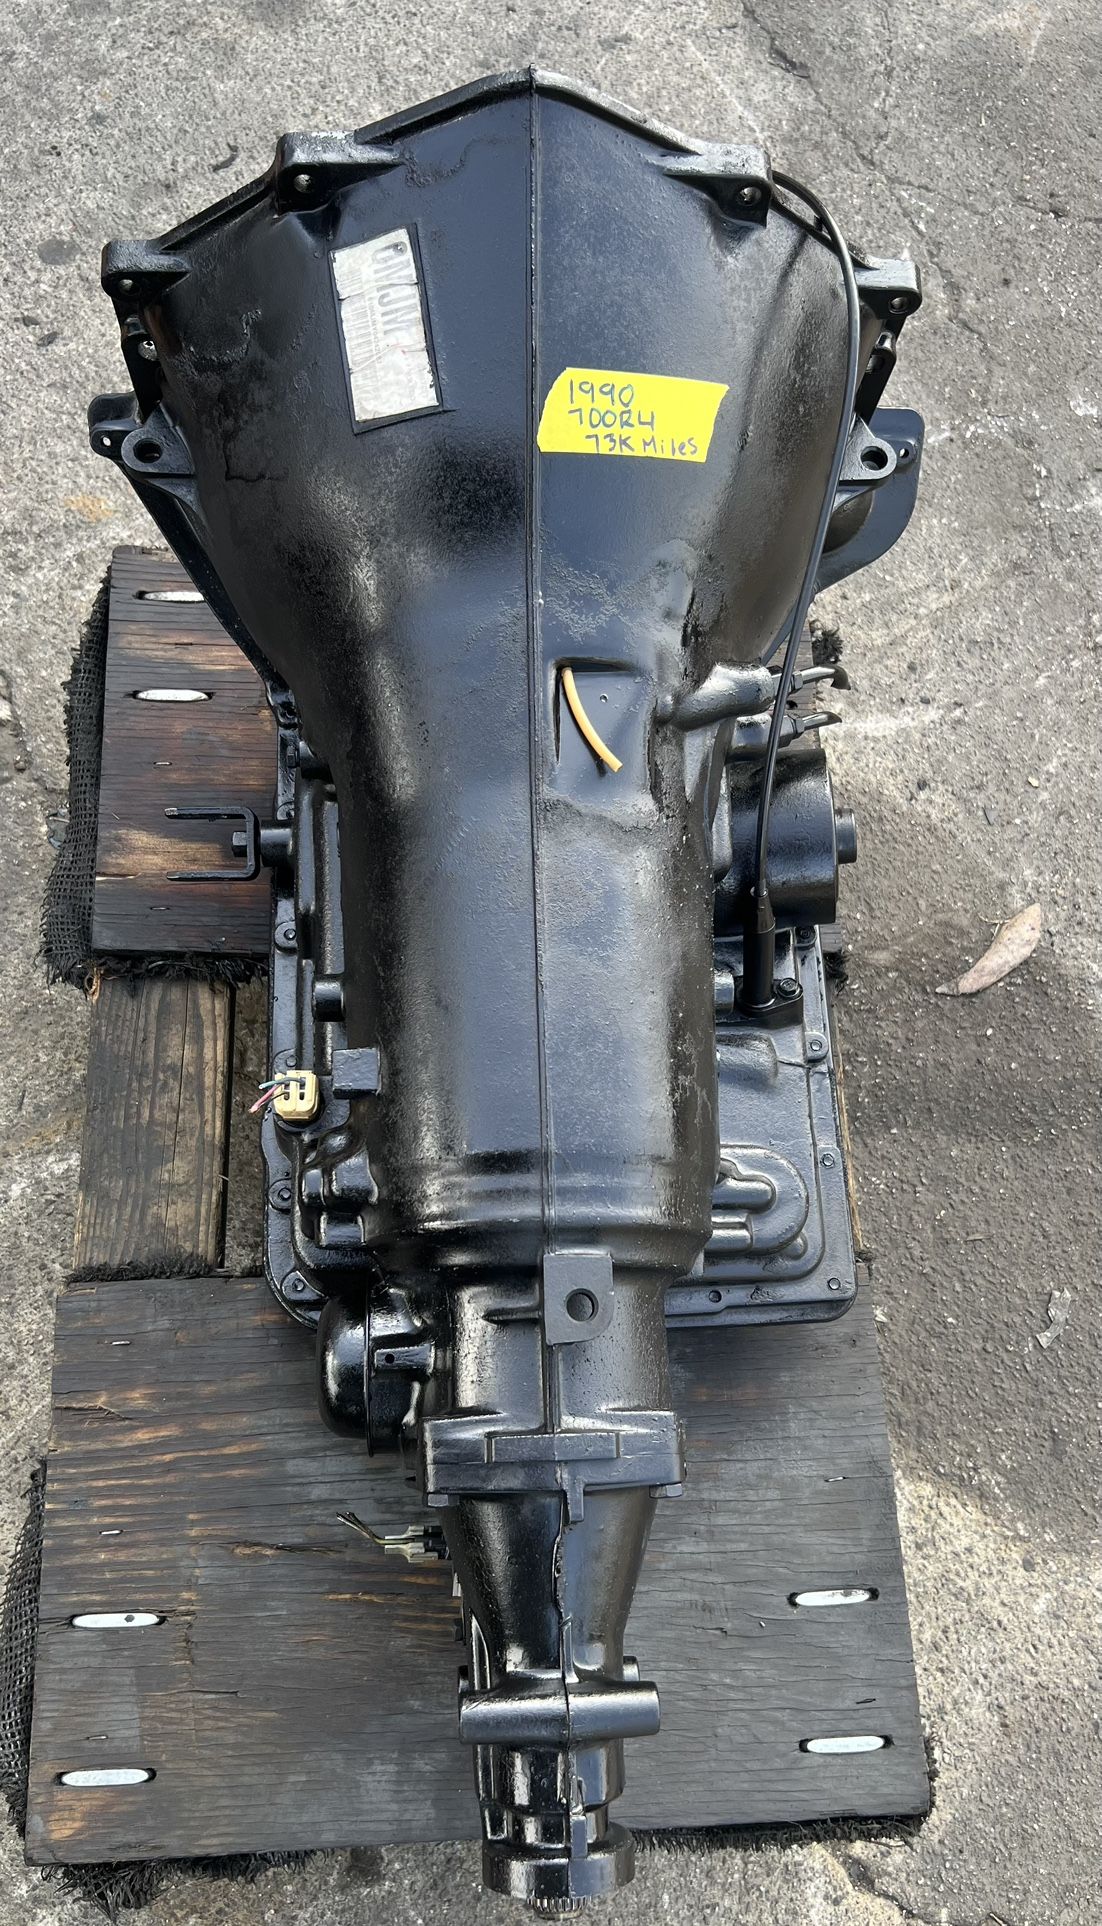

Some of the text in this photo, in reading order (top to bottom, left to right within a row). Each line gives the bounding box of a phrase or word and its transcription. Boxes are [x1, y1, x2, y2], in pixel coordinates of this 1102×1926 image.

[569, 378, 635, 408] 1990
[567, 407, 655, 431] 700R4
[585, 433, 635, 453] 73K
